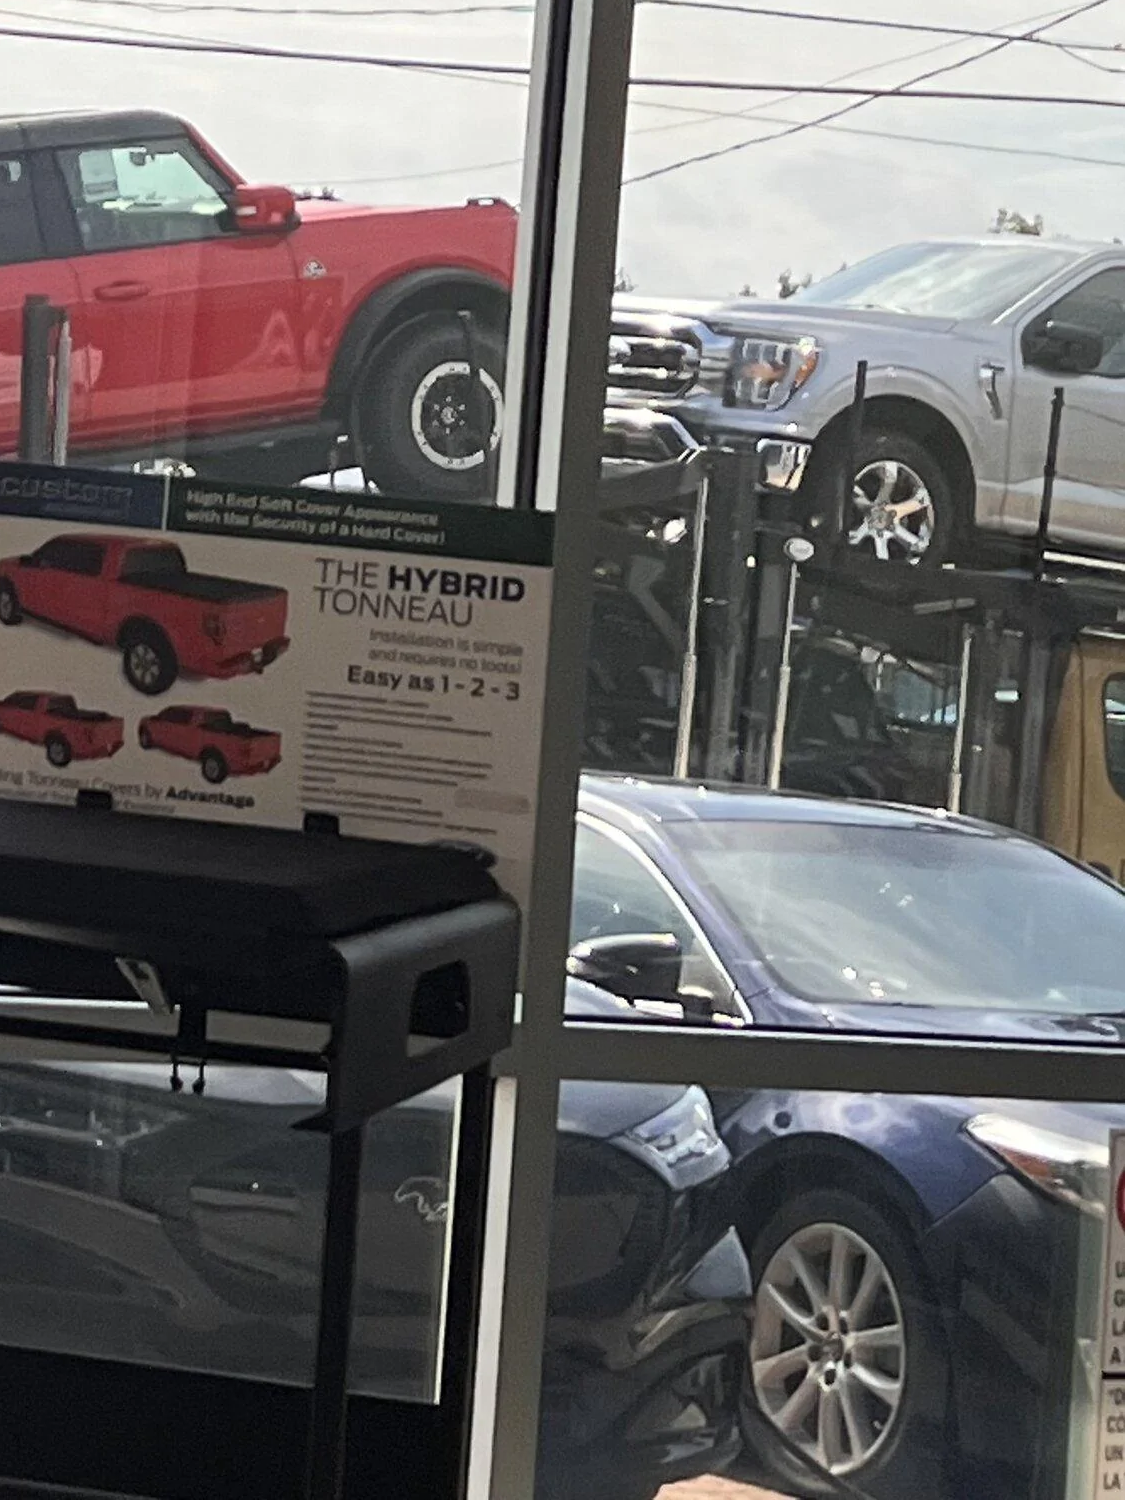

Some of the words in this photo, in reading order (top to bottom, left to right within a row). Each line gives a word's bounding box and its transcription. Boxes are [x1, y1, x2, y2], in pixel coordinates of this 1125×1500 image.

[186, 487, 224, 507] High
[186, 508, 221, 524] with
[223, 511, 251, 526] the
[252, 513, 316, 535] Security
[318, 520, 337, 534] of
[338, 523, 350, 536] a
[351, 524, 392, 540] Hard
[315, 557, 380, 589] THE
[387, 564, 525, 602] HYBRID
[313, 585, 474, 628] TONNEAU
[368, 628, 455, 649] Installation
[457, 637, 470, 652] is
[472, 640, 524, 658] simple
[367, 649, 397, 663] and
[399, 651, 457, 670] requires
[459, 657, 478, 671] no
[347, 664, 403, 691] Easy
[407, 673, 436, 692] as
[440, 673, 450, 694] 1
[470, 676, 486, 698] 2
[504, 680, 521, 701] 3
[144, 783, 163, 800] by
[165, 785, 255, 810] Advantage
